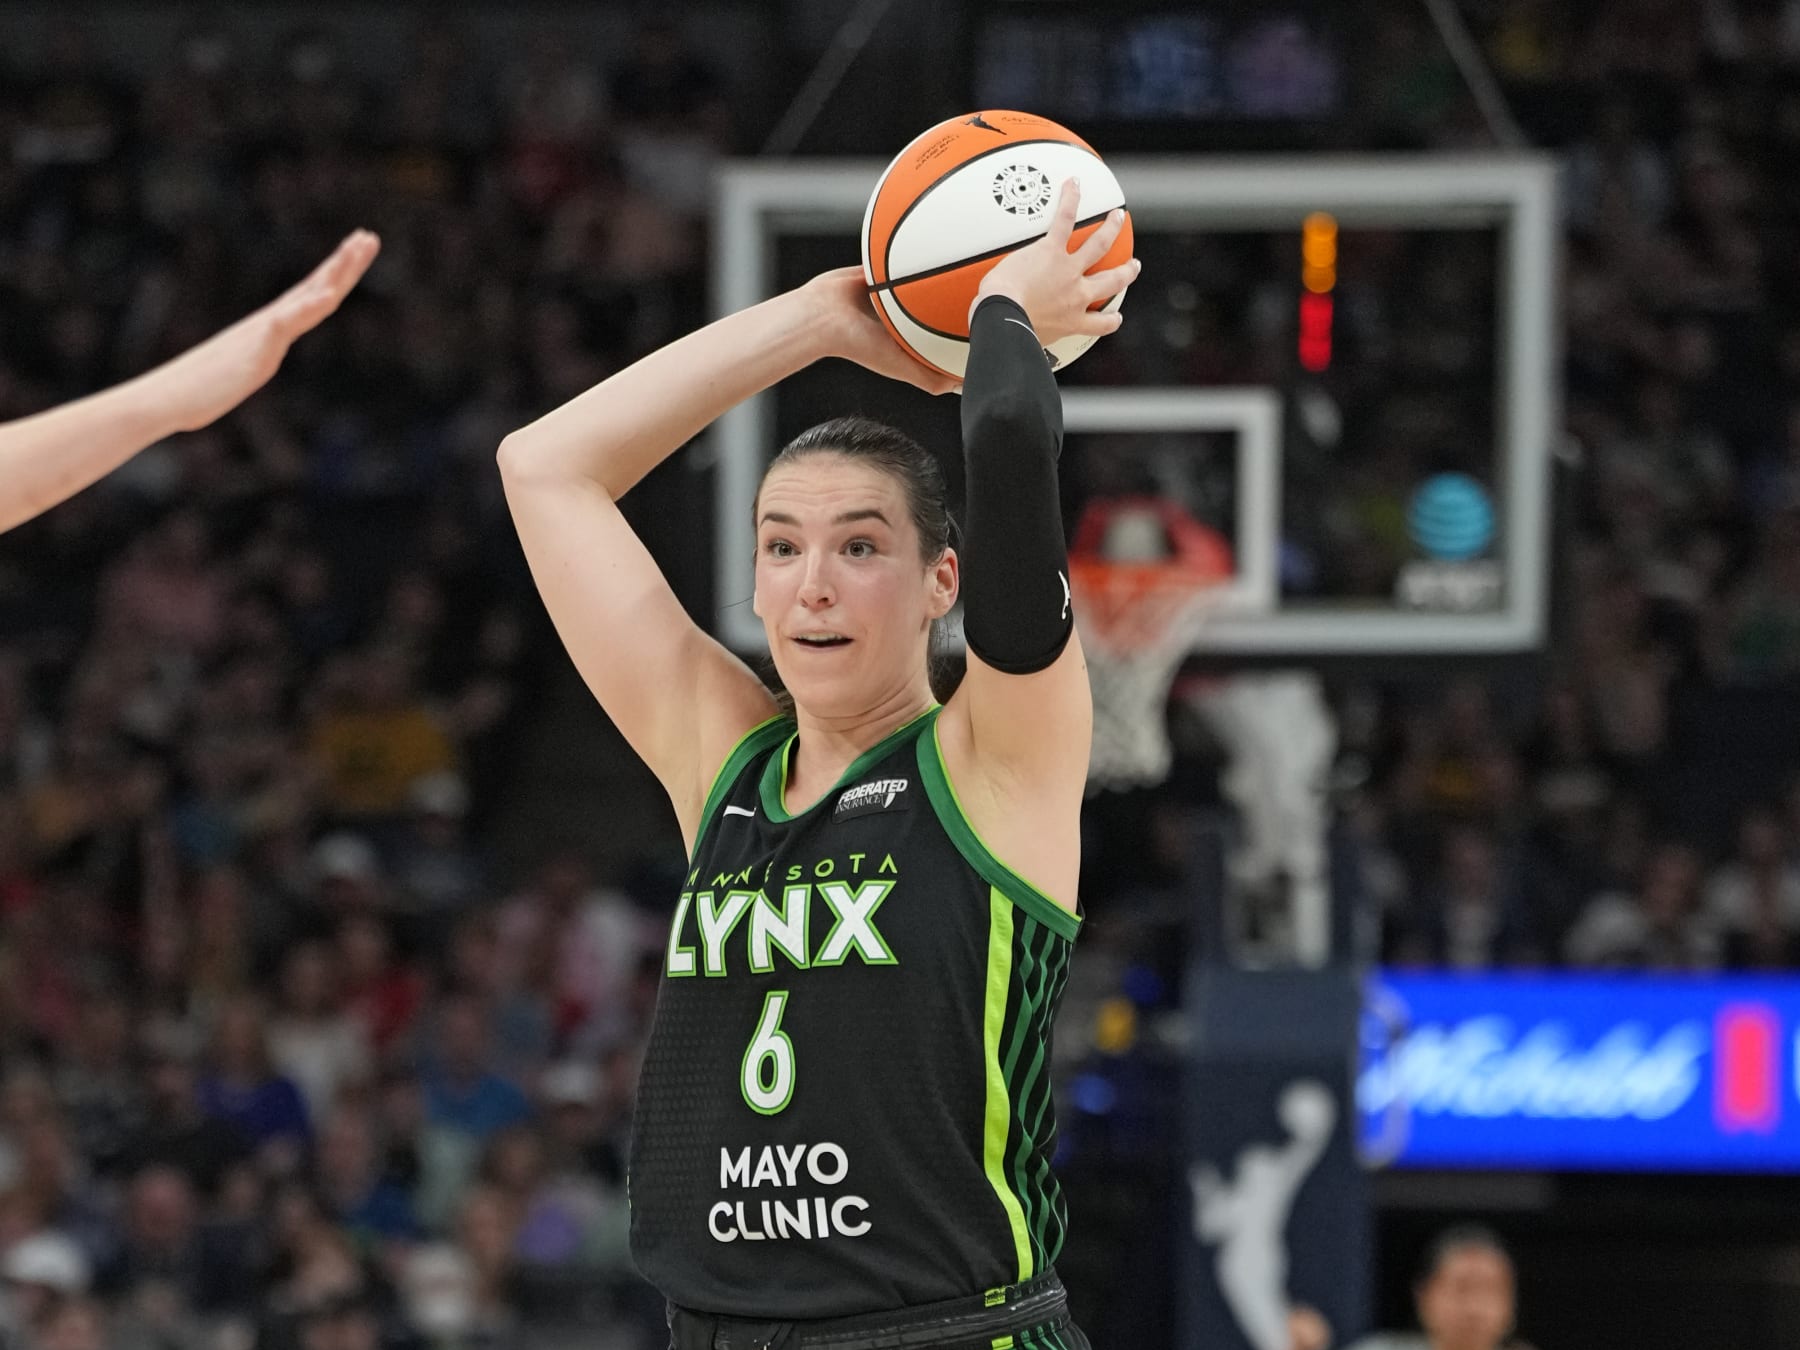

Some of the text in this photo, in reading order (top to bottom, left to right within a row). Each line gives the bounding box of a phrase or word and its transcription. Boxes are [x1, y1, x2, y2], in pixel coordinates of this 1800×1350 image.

[838, 778, 909, 805] FEDERATED
[667, 880, 899, 978] LYNX
[740, 990, 796, 1116] 6
[720, 1142, 849, 1189] MAYO
[708, 1195, 872, 1243] CLINIC
